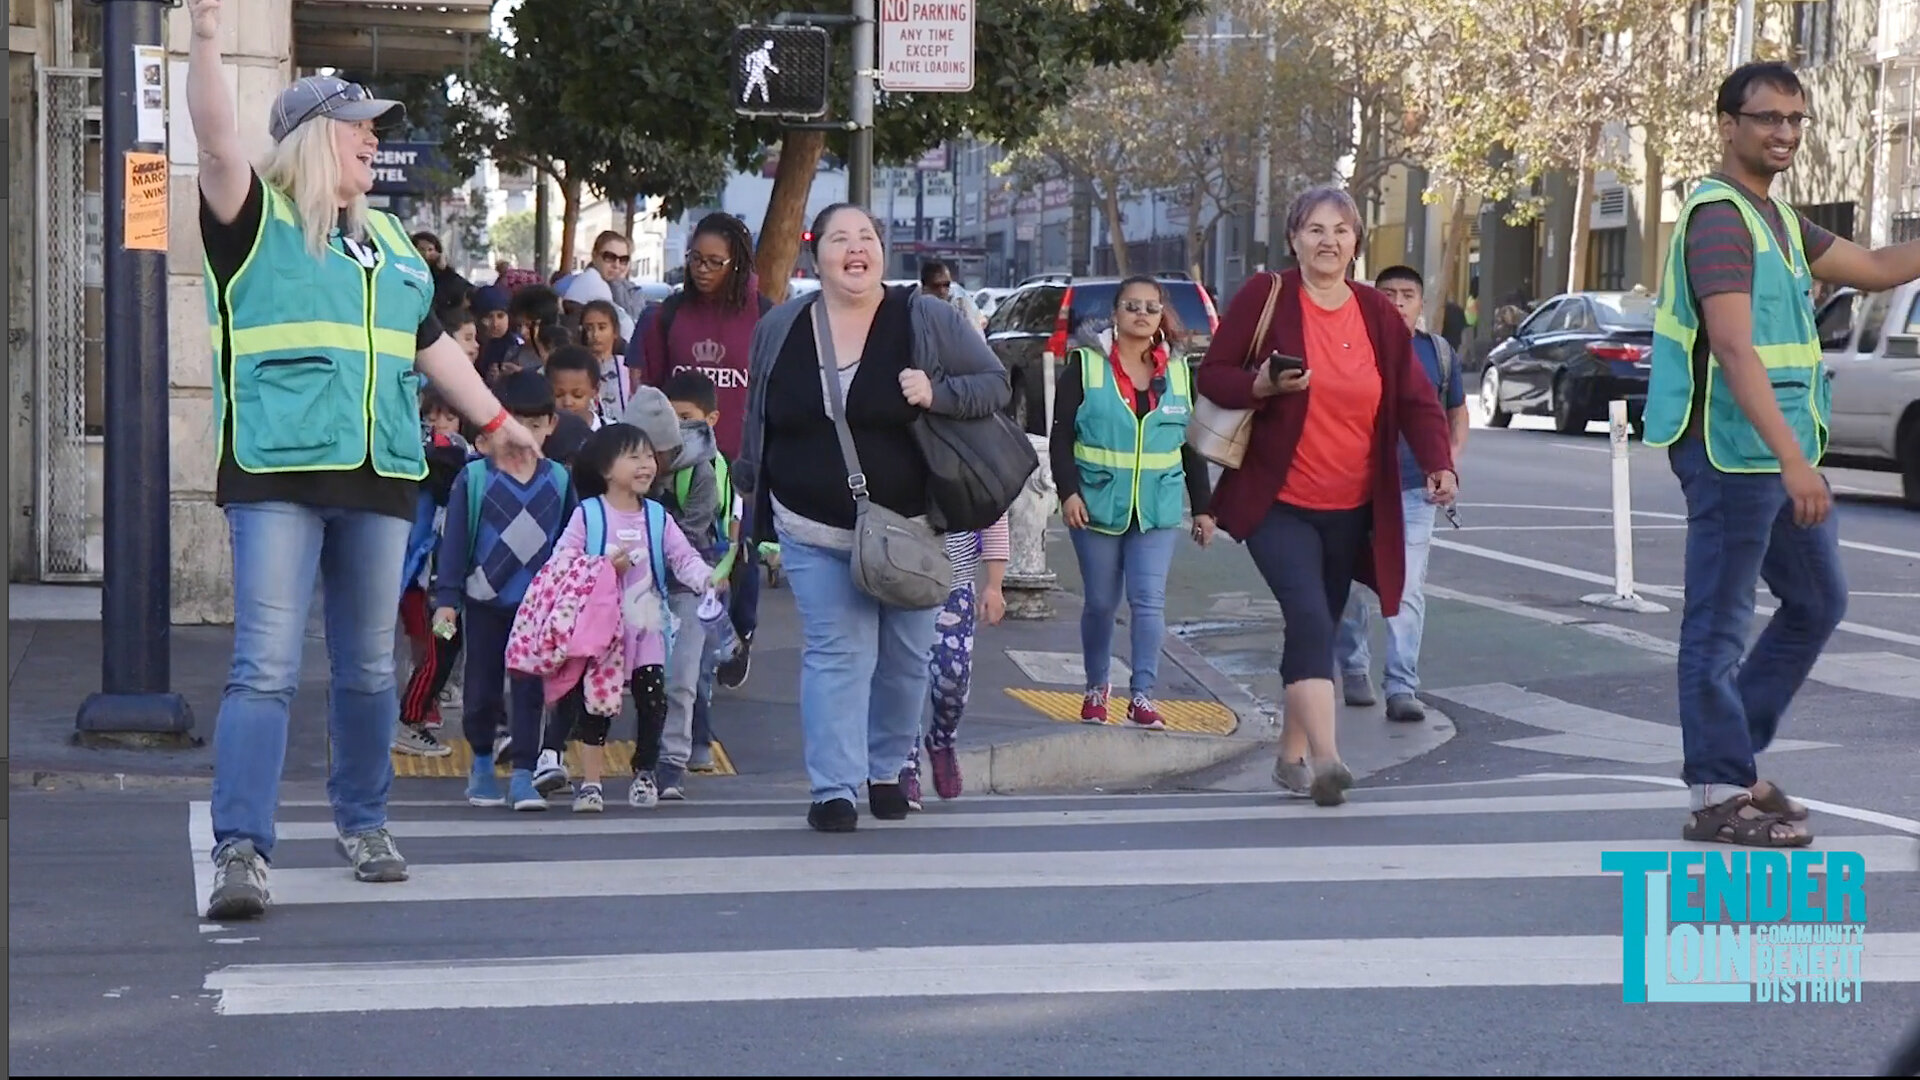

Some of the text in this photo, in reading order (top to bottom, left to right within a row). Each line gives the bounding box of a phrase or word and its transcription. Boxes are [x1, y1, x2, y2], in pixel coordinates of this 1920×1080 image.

[884, 0, 966, 21] NO PARKING
[900, 29, 954, 40] ANY TIME
[906, 45, 948, 57] EXCEPT
[888, 61, 965, 73] ACTIVE LOADING
[373, 151, 418, 164] CENT
[132, 171, 166, 186] MARC
[370, 168, 407, 182] OTEL
